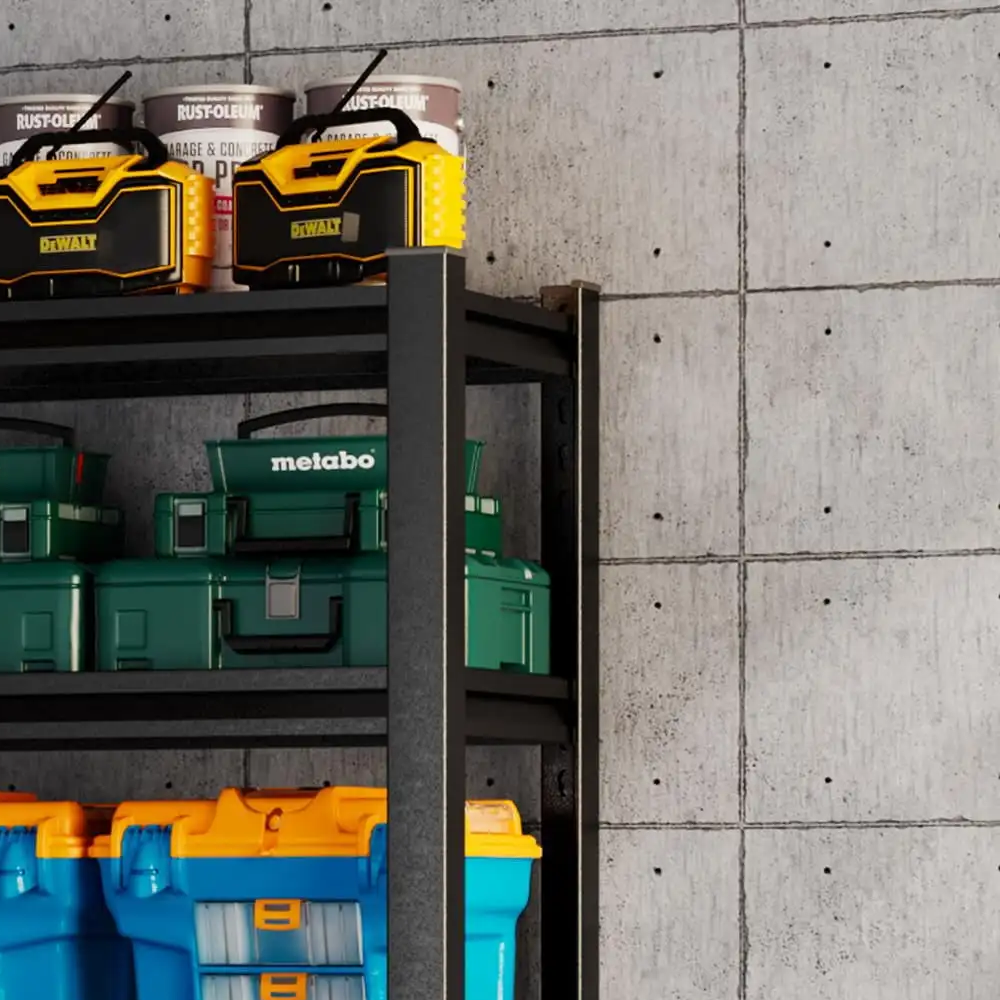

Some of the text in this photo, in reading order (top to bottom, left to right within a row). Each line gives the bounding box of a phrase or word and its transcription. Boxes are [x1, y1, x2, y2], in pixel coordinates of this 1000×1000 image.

[177, 104, 263, 121] RUST-OLEUM
[166, 142, 202, 156] ARAGE
[271, 450, 375, 471] metabo
